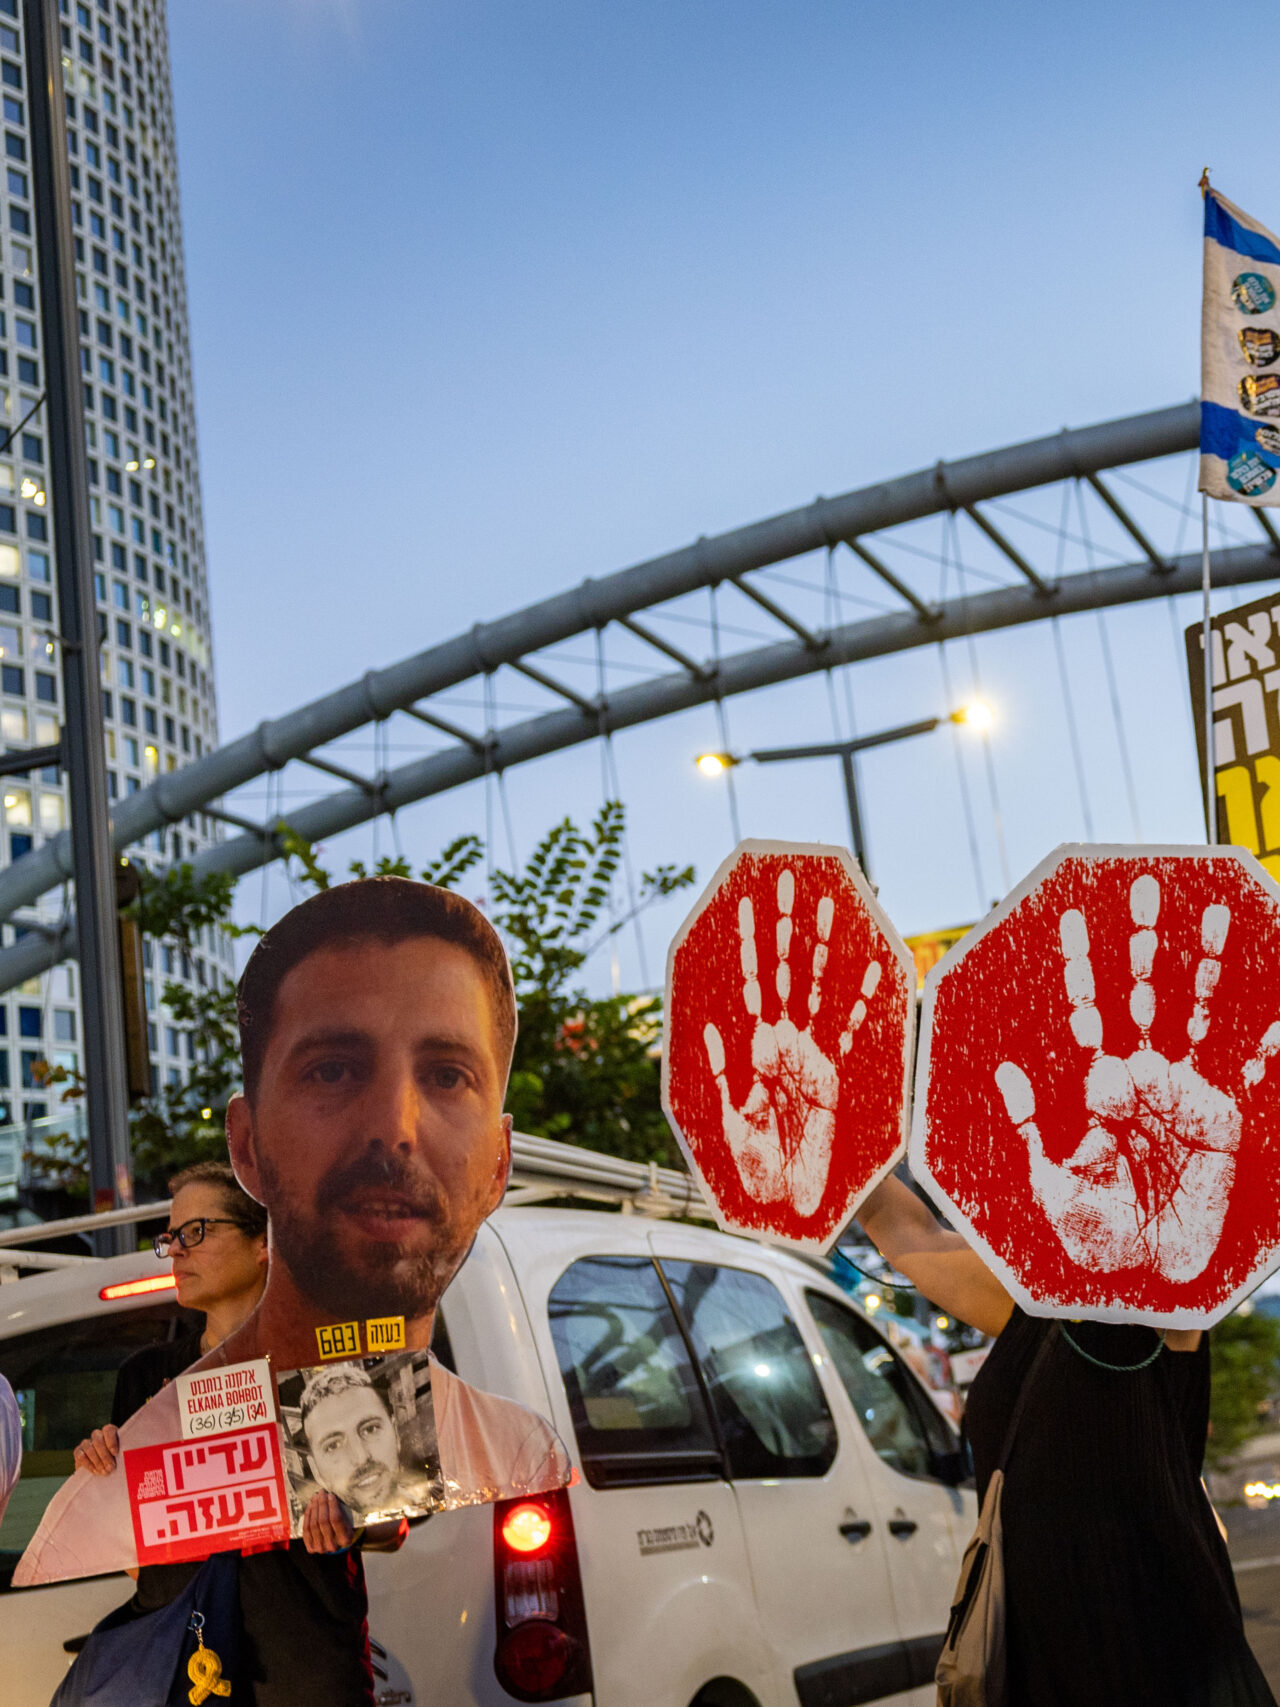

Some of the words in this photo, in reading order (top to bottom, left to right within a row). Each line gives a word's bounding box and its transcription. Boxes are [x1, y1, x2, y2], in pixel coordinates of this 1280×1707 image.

[319, 1324, 357, 1356] 683
[370, 1322, 402, 1344] בעזה
[190, 1376, 224, 1396] בוחבוט
[224, 1369, 257, 1389] אלקנה
[187, 1395, 224, 1415] ELKANA
[226, 1385, 263, 1406] BOHBOT
[189, 1414, 216, 1434] (36)
[171, 1436, 268, 1491] עדיין
[156, 1485, 278, 1540] בעזה.
